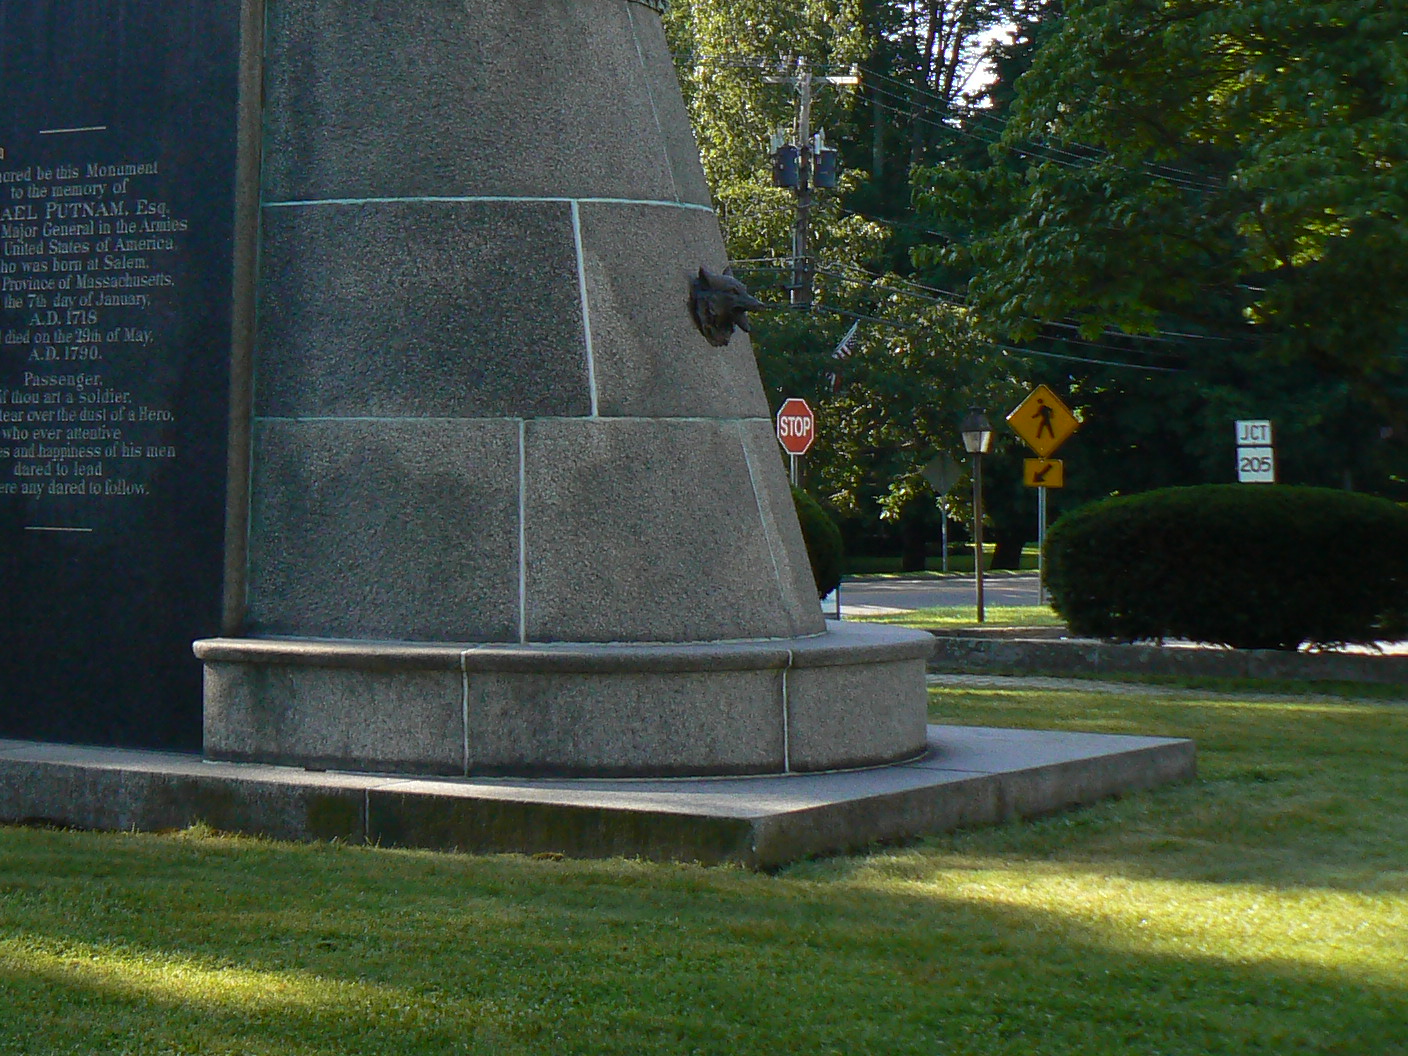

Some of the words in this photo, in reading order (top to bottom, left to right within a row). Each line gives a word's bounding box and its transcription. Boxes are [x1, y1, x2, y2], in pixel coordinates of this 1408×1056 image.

[36, 166, 52, 180] be
[56, 164, 79, 179] this
[85, 161, 158, 177] Monument
[11, 186, 24, 199] to
[26, 185, 47, 198] the
[52, 184, 106, 199] memory
[112, 177, 129, 194] of
[1, 223, 38, 243] Major
[43, 222, 94, 237] General
[99, 220, 111, 234] in
[116, 219, 137, 234] the
[139, 217, 188, 233] Armies
[4, 241, 44, 256] United
[48, 239, 90, 254] States
[96, 237, 111, 252] of
[22, 260, 49, 272] was
[53, 256, 82, 272] born
[2, 276, 55, 292] Province
[58, 274, 72, 290] of
[4, 294, 23, 309] the
[27, 293, 47, 308] 7th
[53, 292, 77, 308] day
[79, 291, 94, 306] of
[5, 329, 30, 344] died
[34, 331, 50, 344] on
[53, 329, 73, 343] the
[106, 327, 121, 342] of
[28, 346, 61, 361] A.D.
[11, 390, 39, 404] thou
[0, 408, 24, 422] tear
[27, 410, 55, 422] over
[57, 406, 76, 422] the
[79, 406, 106, 422] dust
[110, 406, 126, 422] of
[2, 426, 29, 440] who
[33, 428, 63, 440] ever
[66, 424, 121, 440] attentive
[780, 416, 811, 437] STOP
[1240, 424, 1271, 441] JCT
[13, 443, 35, 458] and
[38, 442, 101, 461] happiness
[105, 441, 119, 458] of
[122, 442, 142, 458] his
[146, 445, 176, 458] men
[13, 462, 52, 476] dared
[56, 462, 69, 476] to
[74, 462, 103, 476] lead
[1240, 456, 1272, 473] 205
[21, 482, 44, 500] any
[48, 479, 86, 495] dared
[89, 482, 102, 495] to
